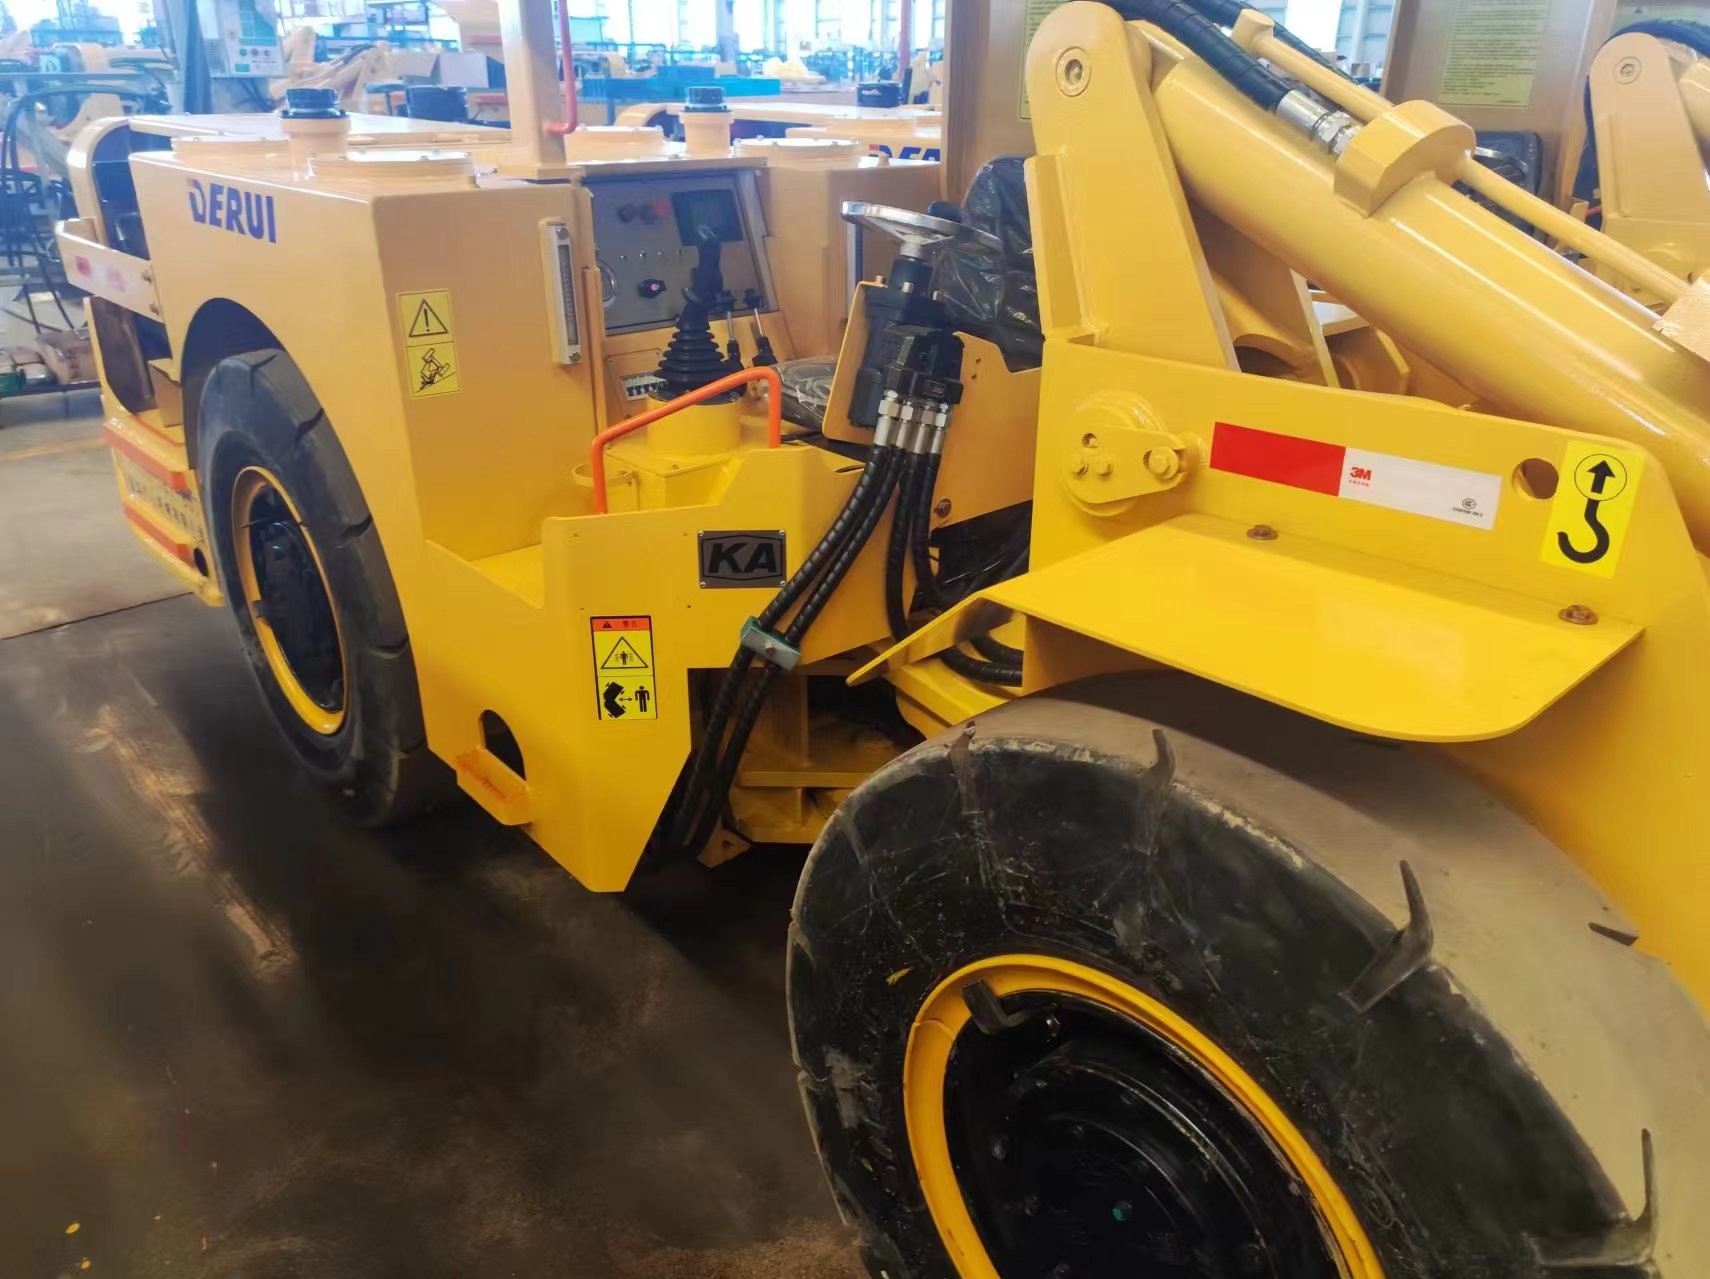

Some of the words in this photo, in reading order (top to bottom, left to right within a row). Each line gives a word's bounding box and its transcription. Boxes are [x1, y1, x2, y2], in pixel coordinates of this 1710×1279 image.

[188, 178, 277, 244] DERUI
[1350, 466, 1371, 481] 3M
[708, 543, 777, 573] KA
